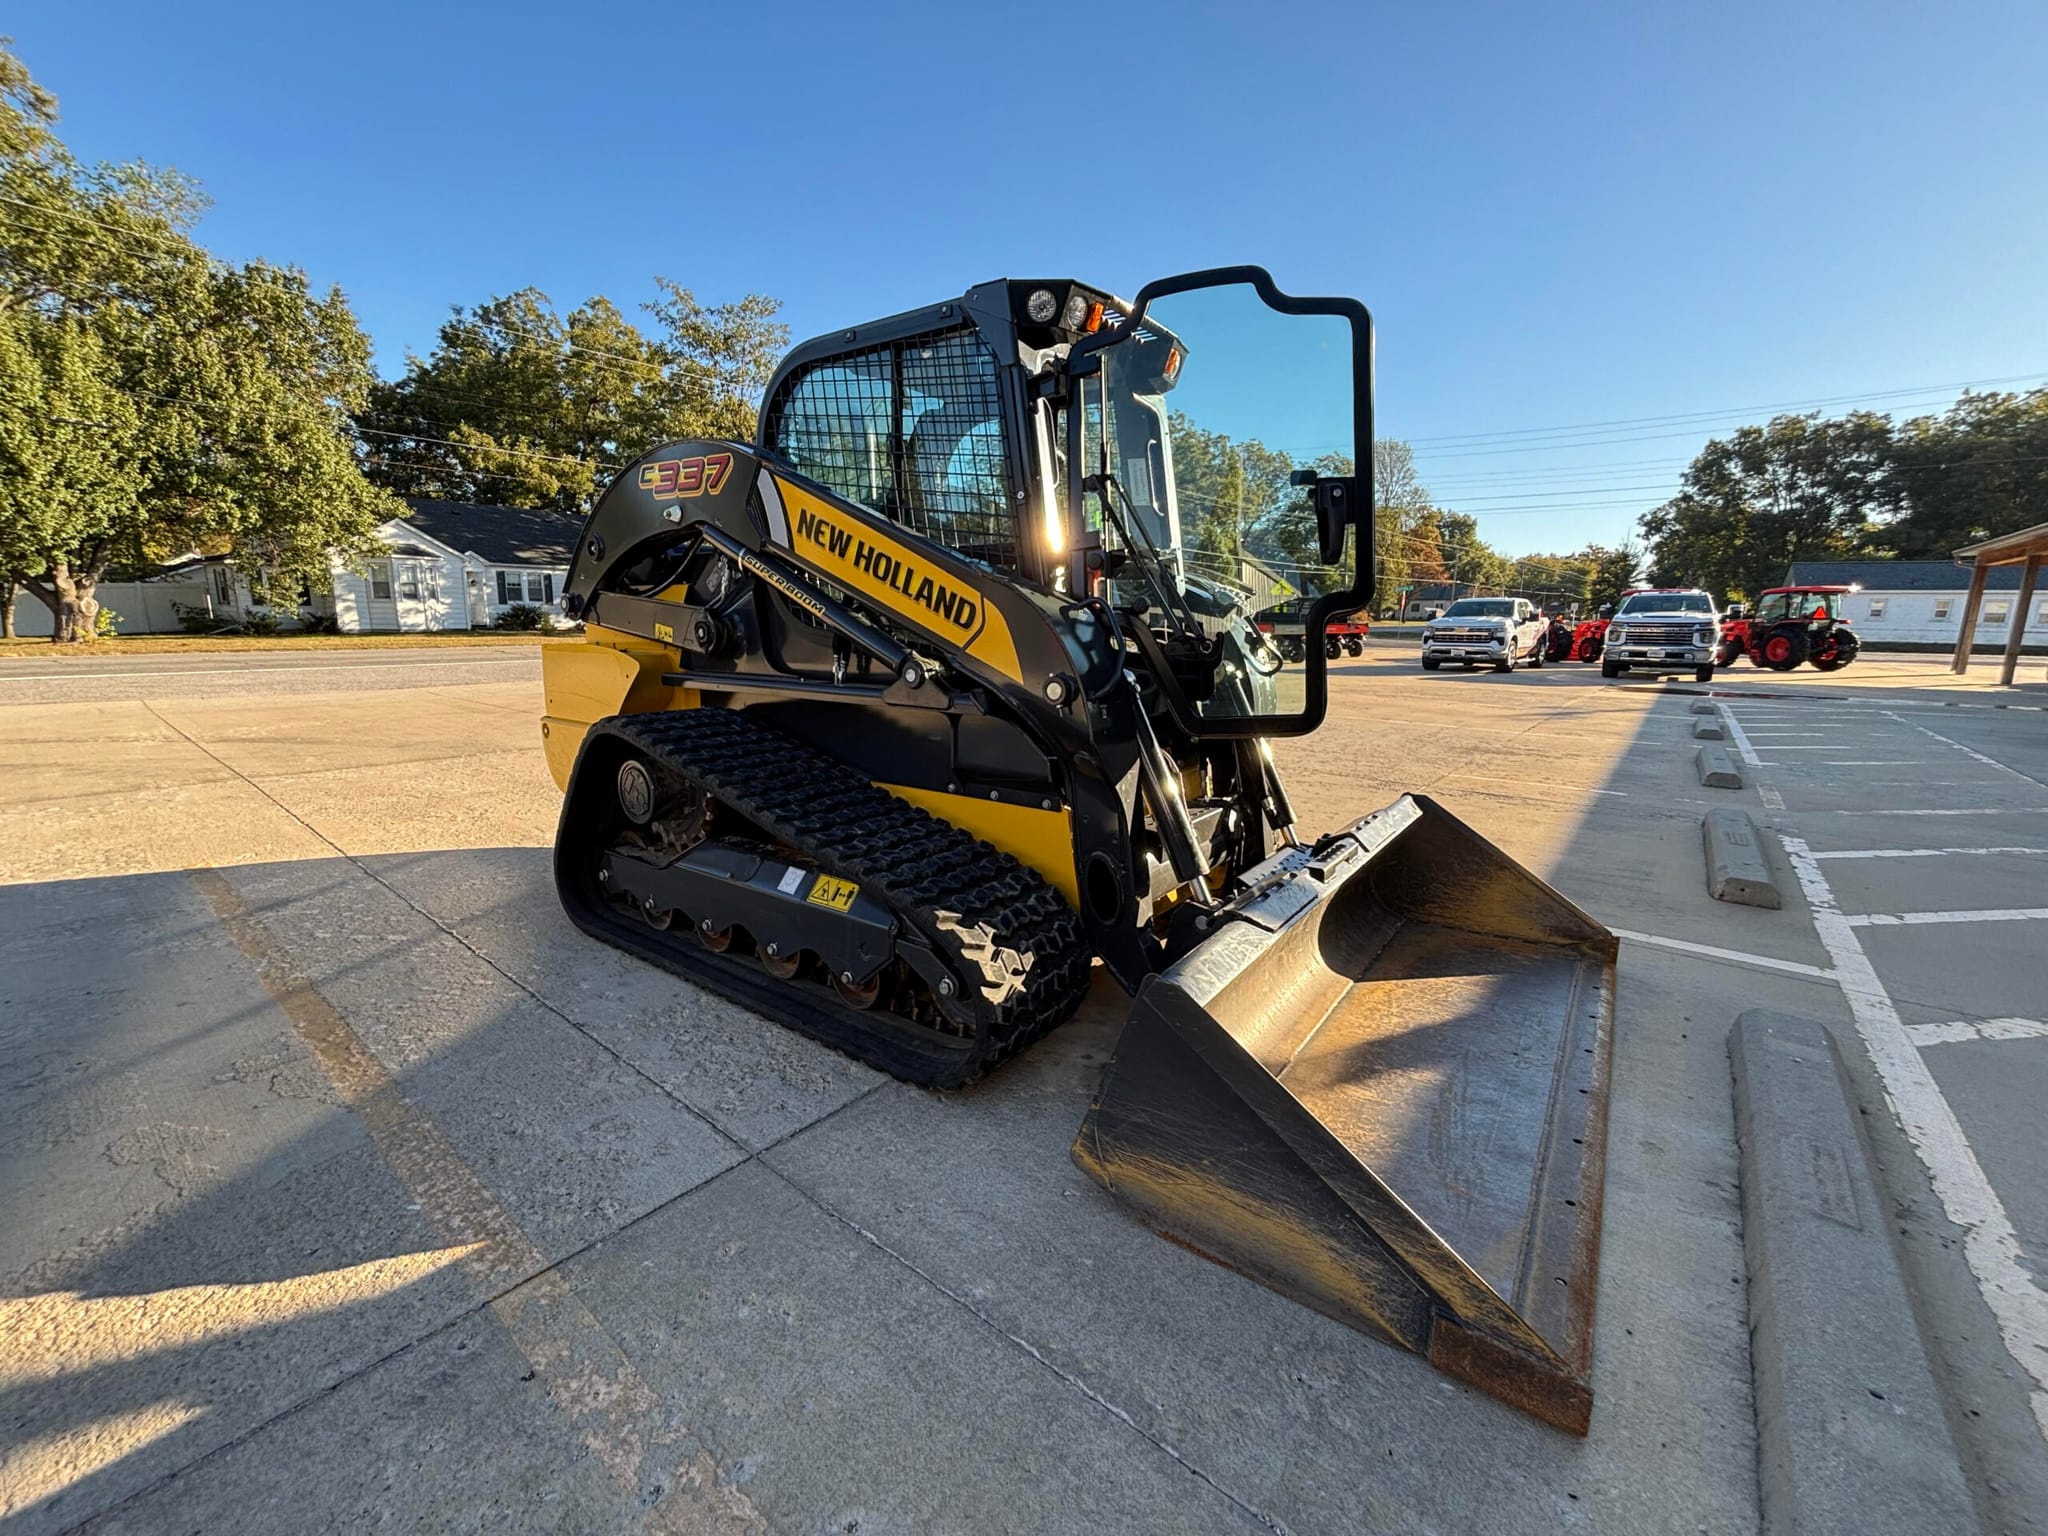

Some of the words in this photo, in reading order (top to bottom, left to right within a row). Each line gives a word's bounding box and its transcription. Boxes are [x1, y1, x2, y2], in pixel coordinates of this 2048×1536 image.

[639, 453, 734, 500] C337
[797, 507, 853, 559] NEW
[854, 540, 977, 630] HOLLAND
